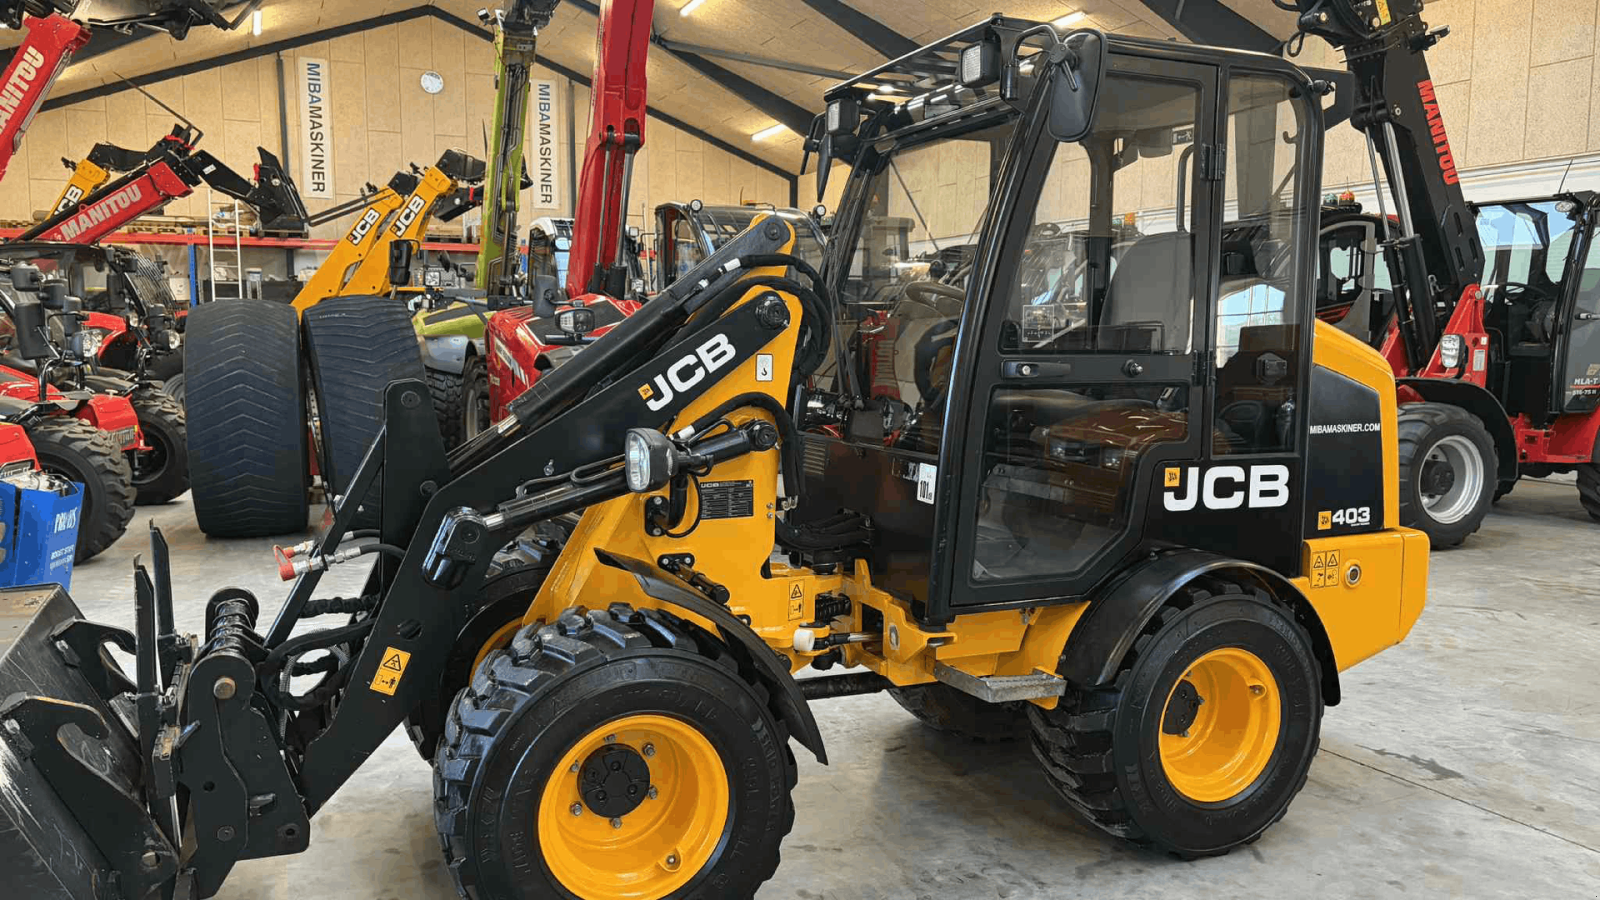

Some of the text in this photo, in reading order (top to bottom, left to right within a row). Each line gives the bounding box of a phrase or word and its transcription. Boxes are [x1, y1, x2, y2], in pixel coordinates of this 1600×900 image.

[0, 45, 45, 135] ANITOU
[306, 62, 326, 193] MIBAMASKINER
[538, 83, 553, 204] MIBAMASKINER
[1416, 79, 1460, 186] MANITOU
[54, 184, 84, 216] CB
[60, 184, 142, 241] MANITOU
[390, 195, 426, 237] JCB
[347, 208, 381, 245] JCB
[646, 333, 736, 412] JCB
[1309, 422, 1381, 434] MIBAMASKINER.COM
[1163, 464, 1290, 512] JCB
[1332, 506, 1371, 525] 403
